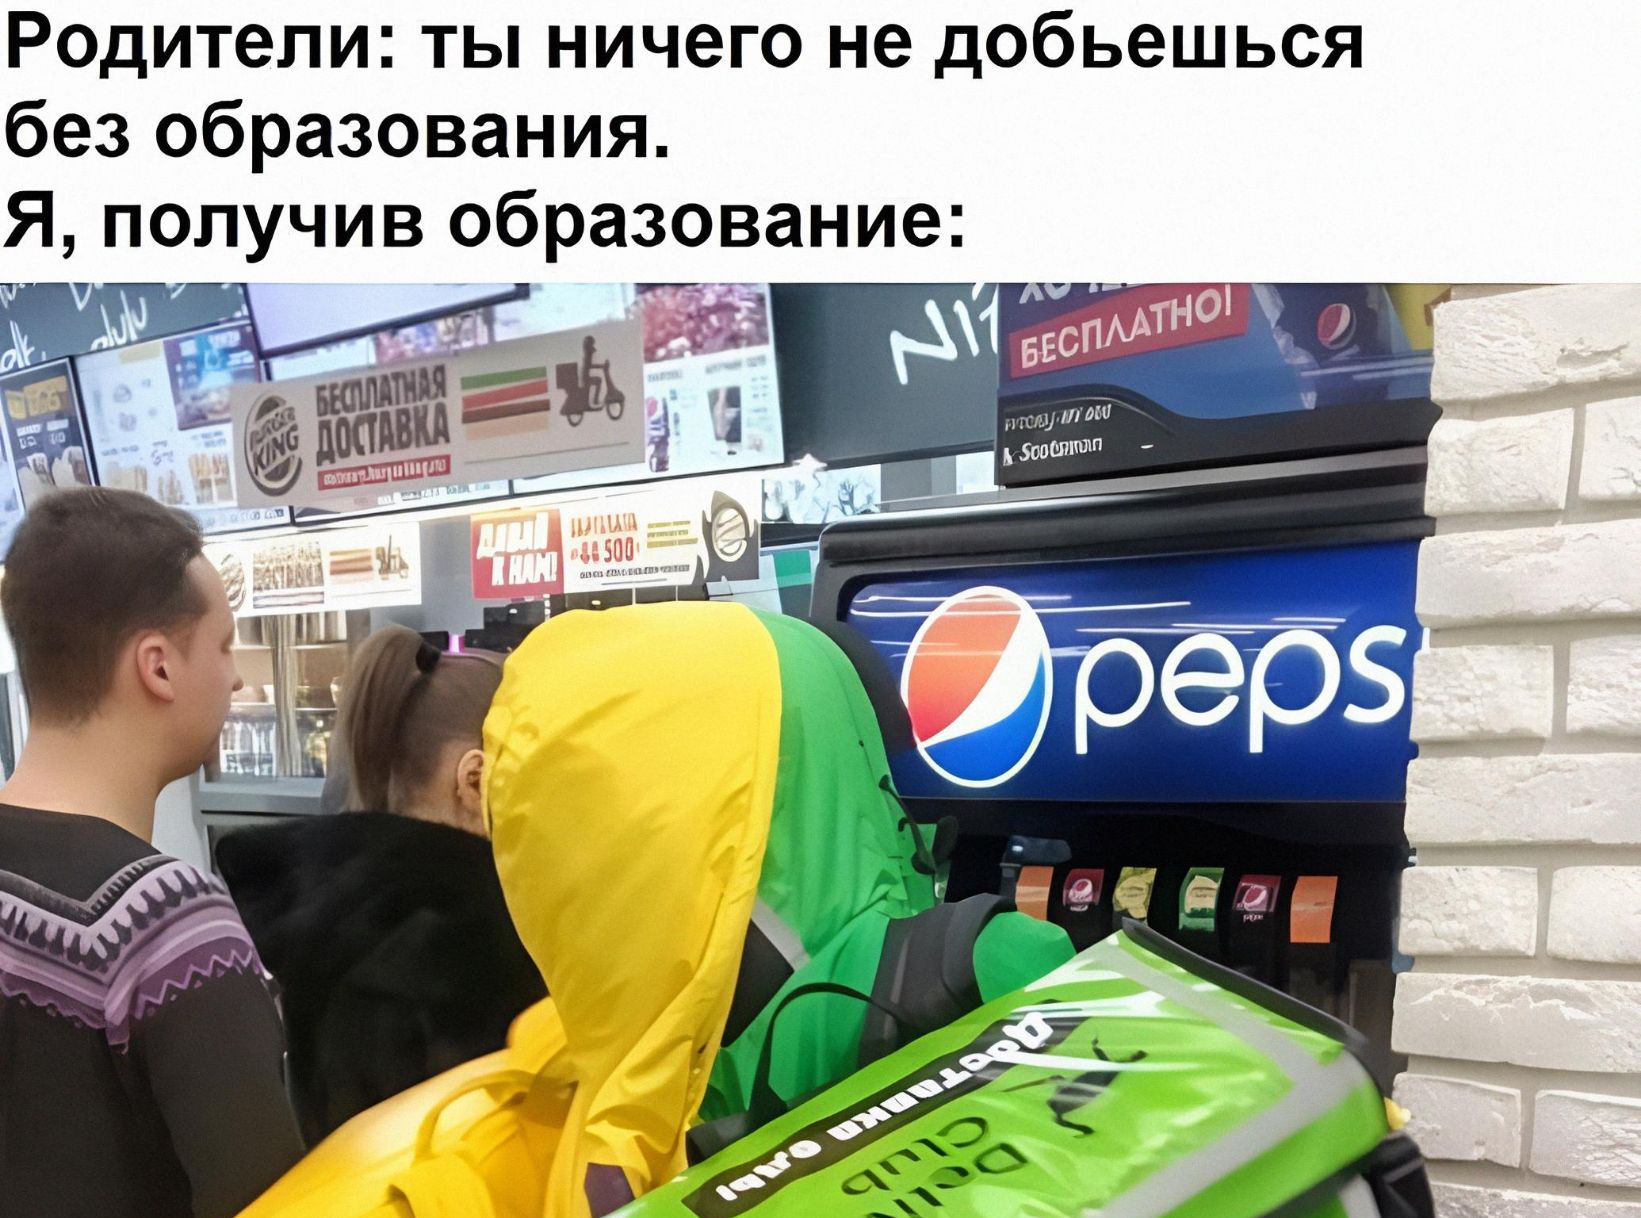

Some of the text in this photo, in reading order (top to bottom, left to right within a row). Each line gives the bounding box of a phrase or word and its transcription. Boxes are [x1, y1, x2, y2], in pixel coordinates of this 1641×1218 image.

[315, 364, 447, 417] БЕСПЛАТНАЯ
[252, 424, 299, 476] KING
[316, 402, 450, 466] ДОСТАВКА
[1075, 625, 1407, 754] peps
[841, 1117, 988, 1195] Club
